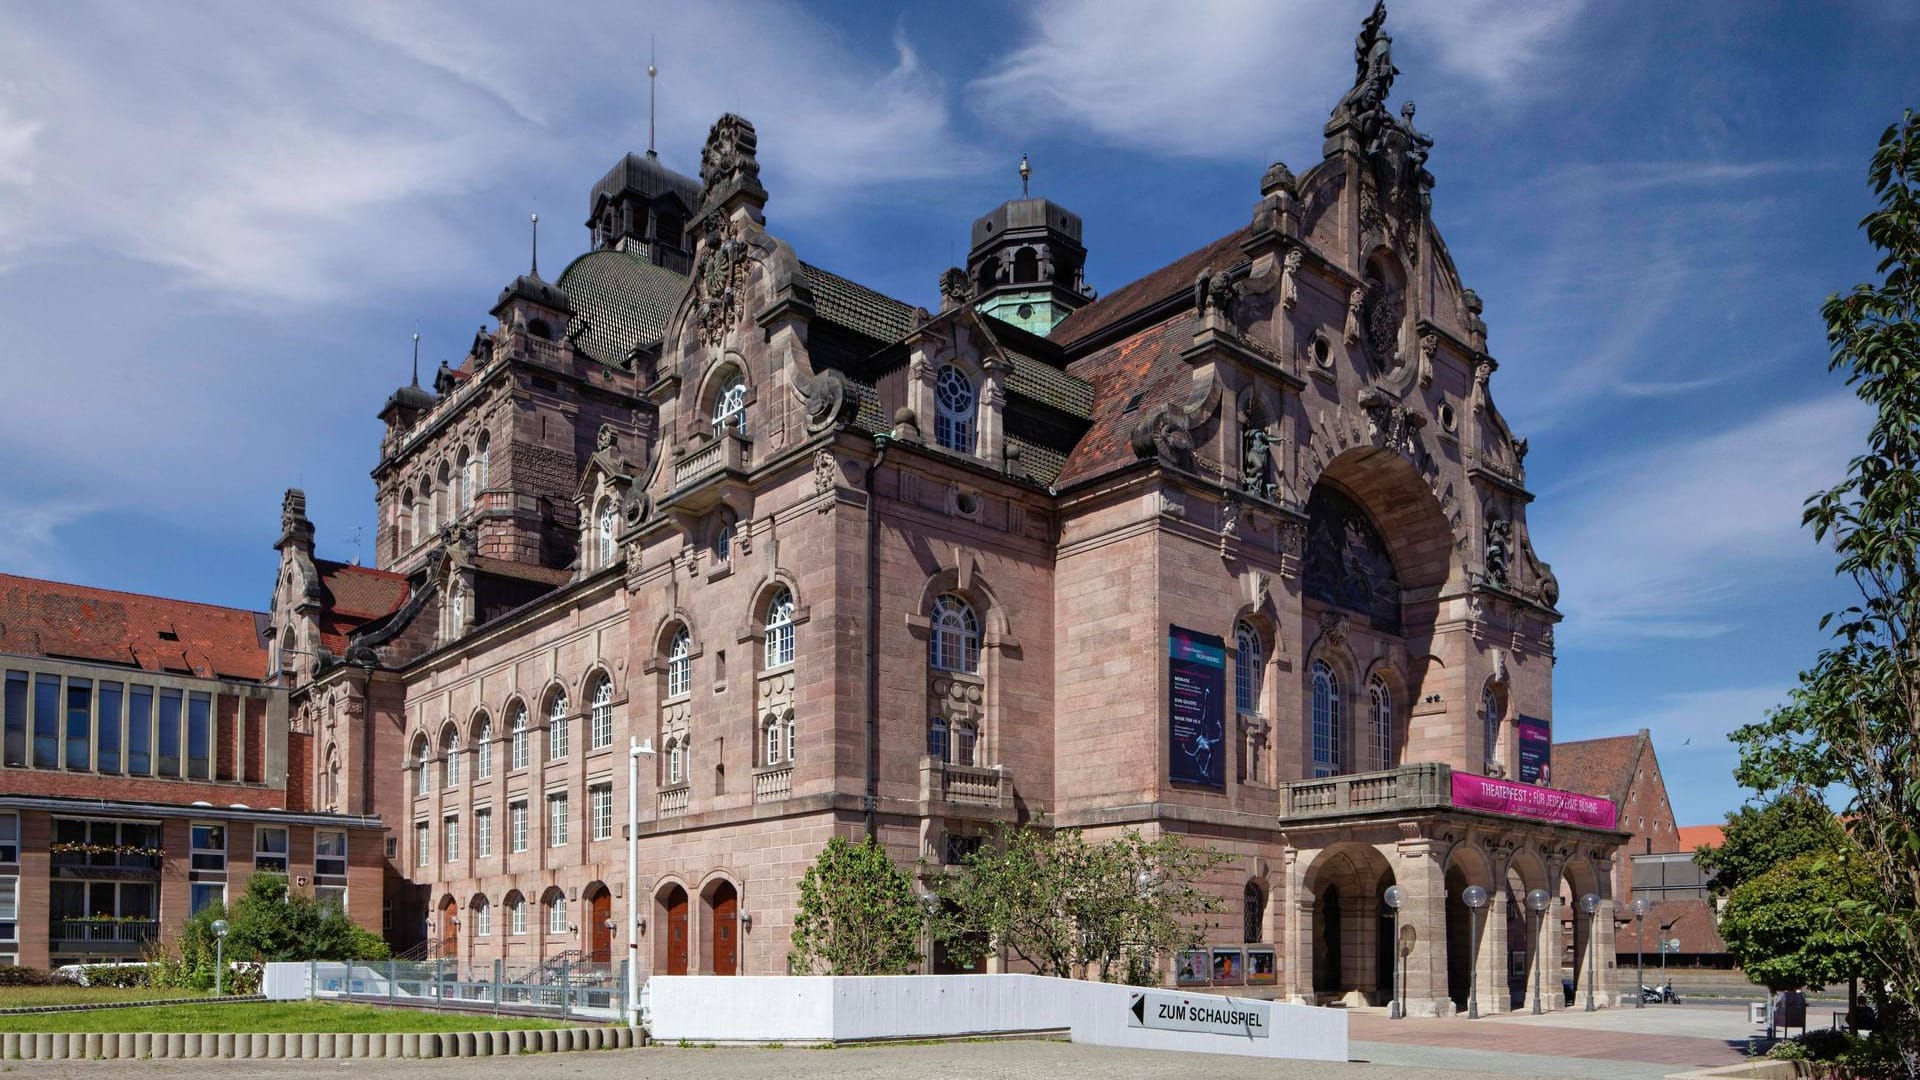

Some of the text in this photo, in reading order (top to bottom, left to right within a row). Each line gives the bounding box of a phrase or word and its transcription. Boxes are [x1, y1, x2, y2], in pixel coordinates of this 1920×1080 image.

[1533, 790, 1545, 805] FÜR
[1578, 797, 1598, 814] BÜHNE
[1158, 1004, 1263, 1027] ZUM SCHAUSPIEL
